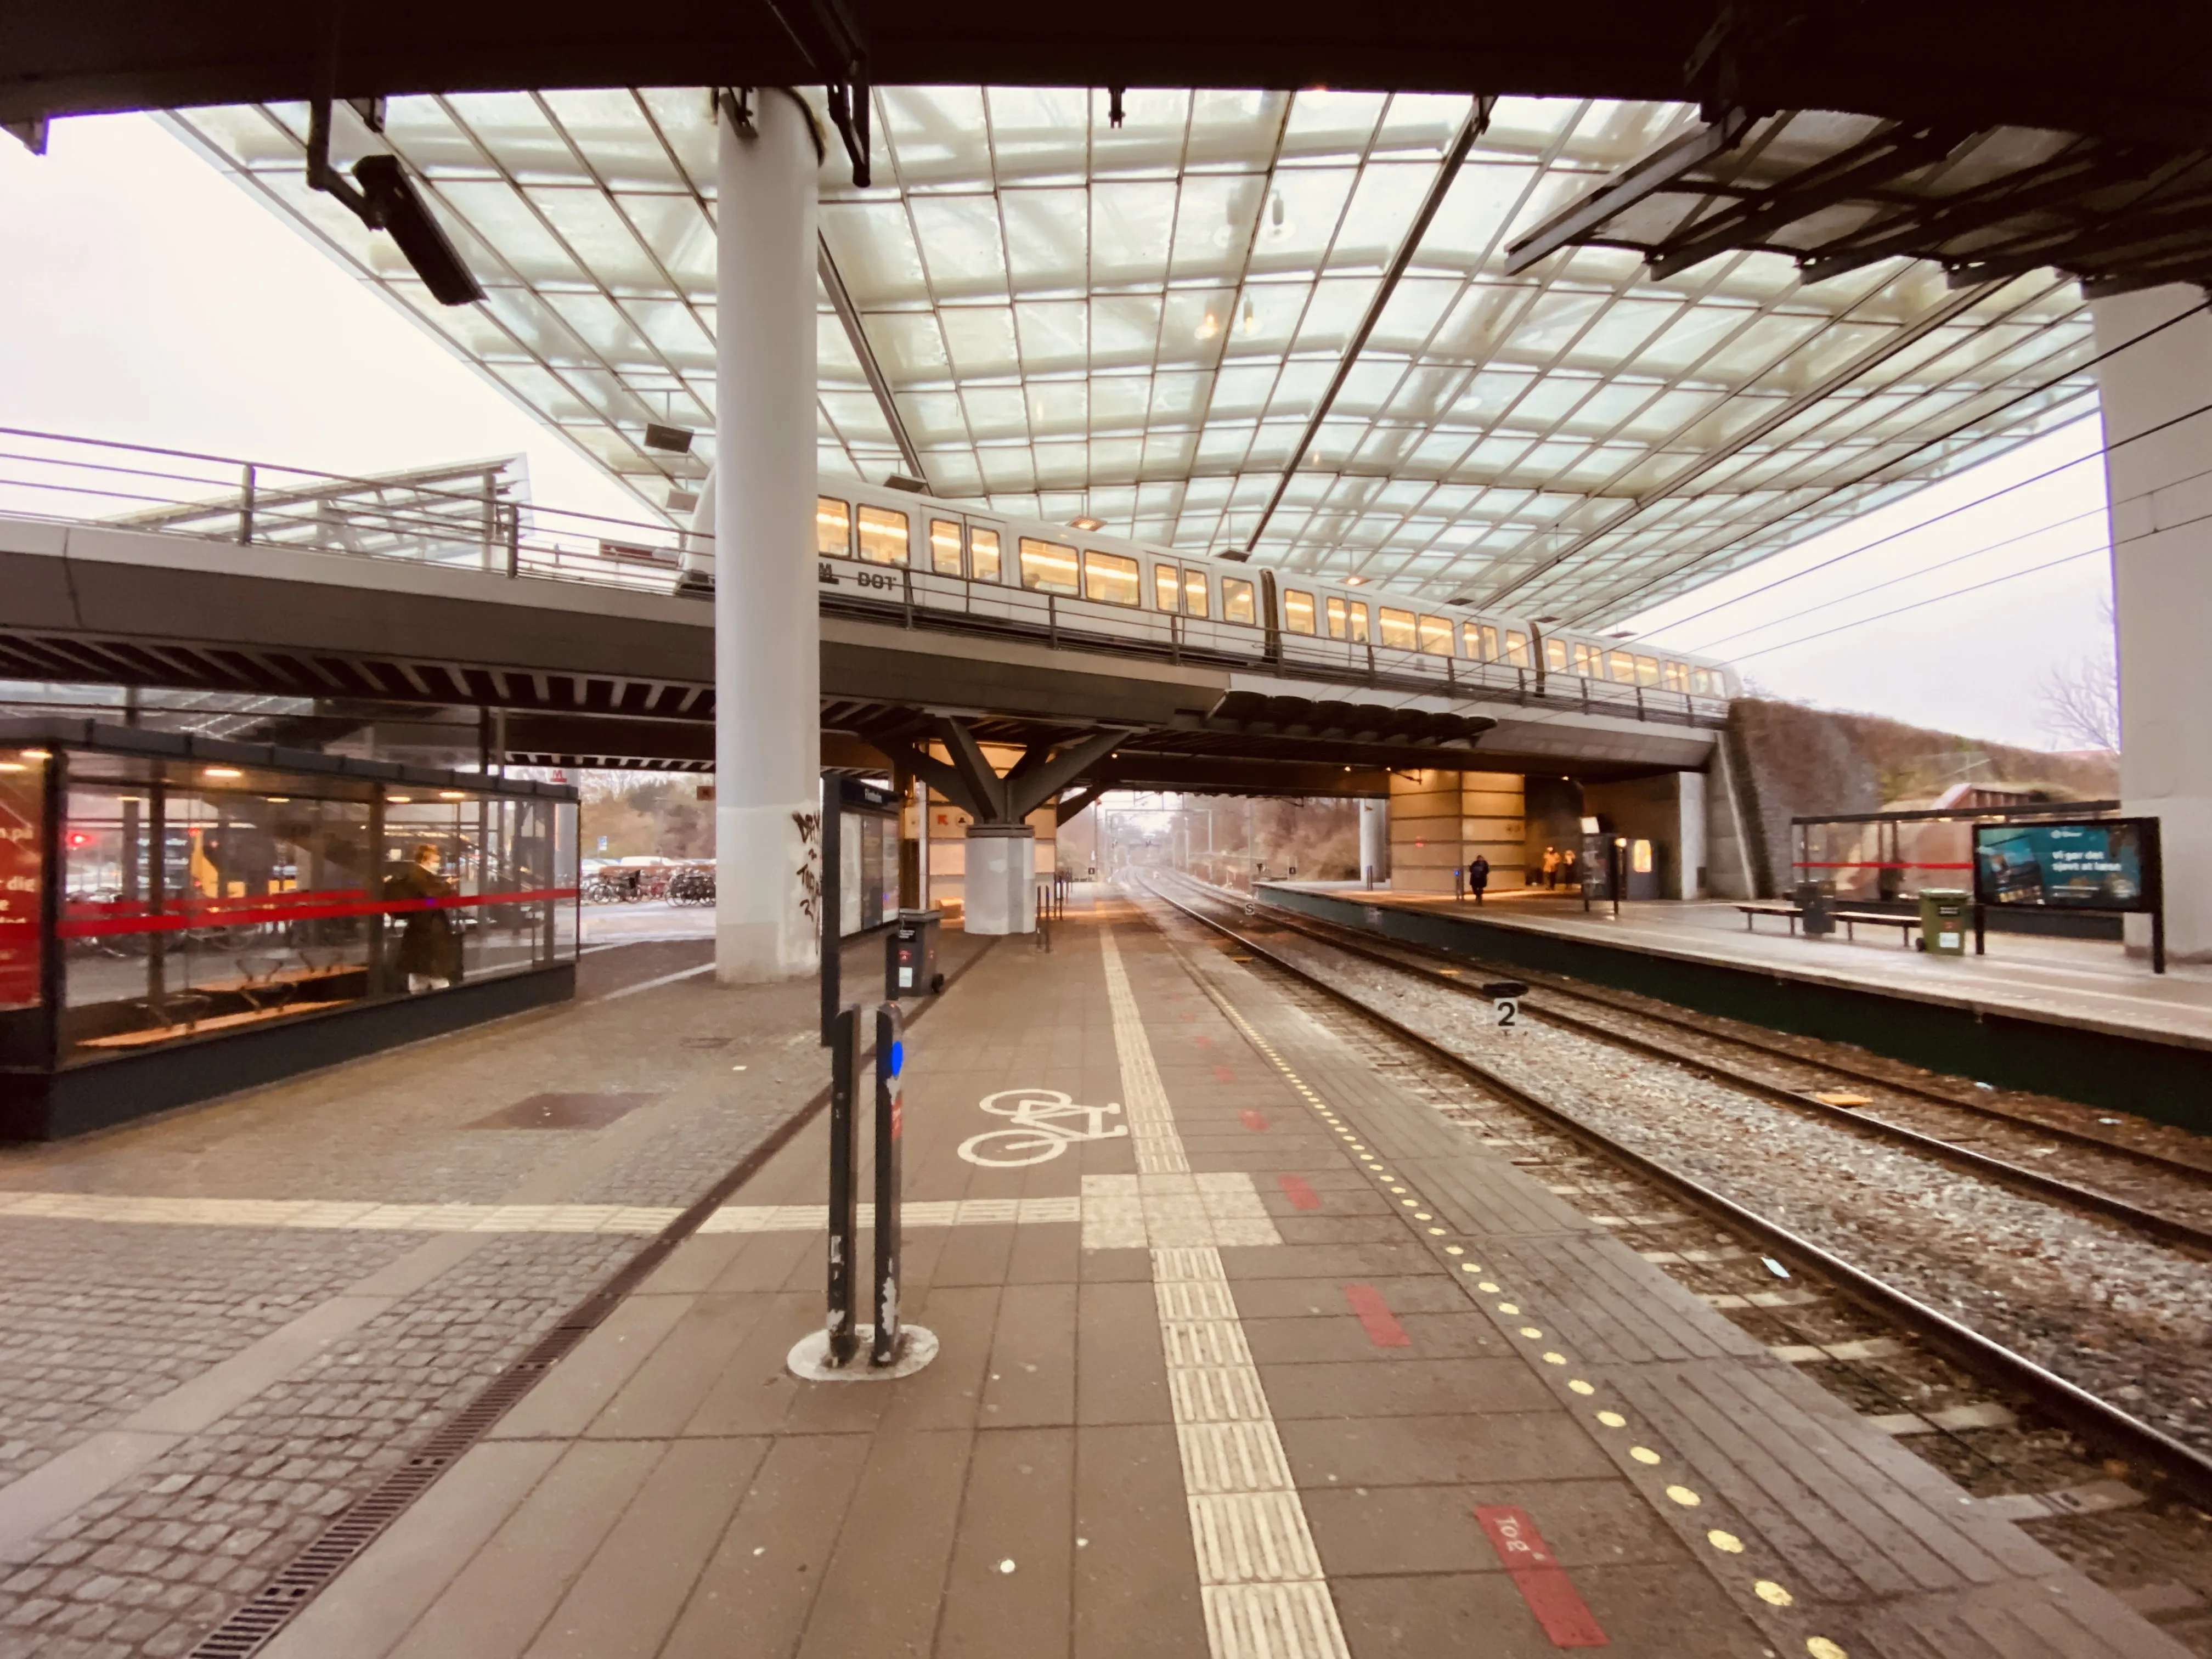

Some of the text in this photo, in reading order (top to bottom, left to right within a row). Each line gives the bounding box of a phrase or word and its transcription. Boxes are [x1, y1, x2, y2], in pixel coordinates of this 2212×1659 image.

[857, 572, 897, 591] DOT
[1246, 903, 1254, 914] S
[1498, 1002, 1515, 1027] 2
